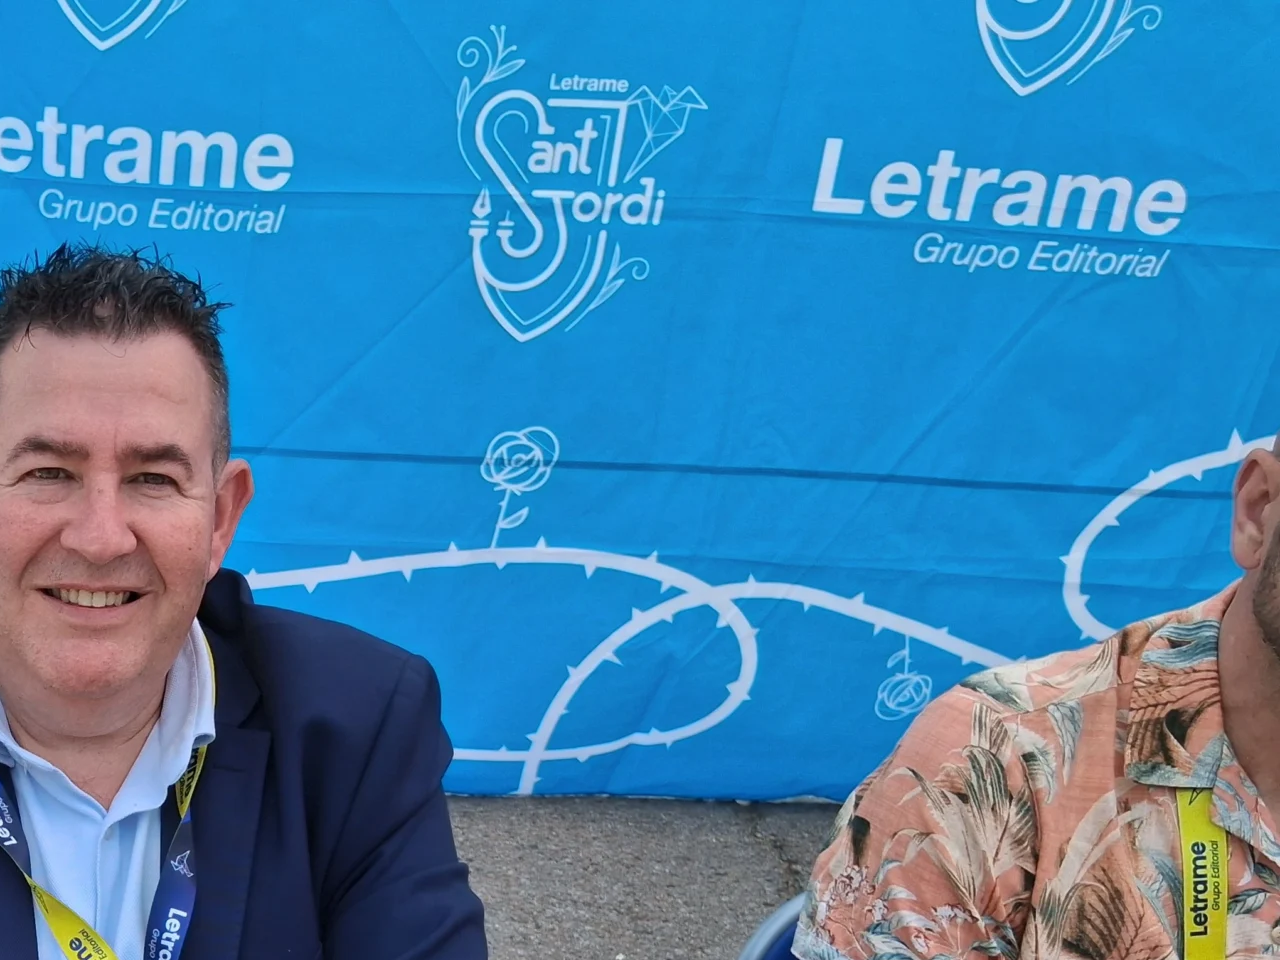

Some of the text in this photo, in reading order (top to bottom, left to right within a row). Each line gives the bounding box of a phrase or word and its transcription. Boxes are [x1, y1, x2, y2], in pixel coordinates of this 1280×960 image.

[549, 73, 630, 92] Letrame
[812, 137, 1188, 236] Letrame
[38, 188, 286, 234] Grupo Editorial
[912, 232, 1171, 277] Grupo Editorial
[1190, 841, 1209, 937] Letrame
[1209, 840, 1222, 911] Grupo Editorial
[79, 928, 108, 960] Editorial
[149, 928, 160, 959] Grupo
